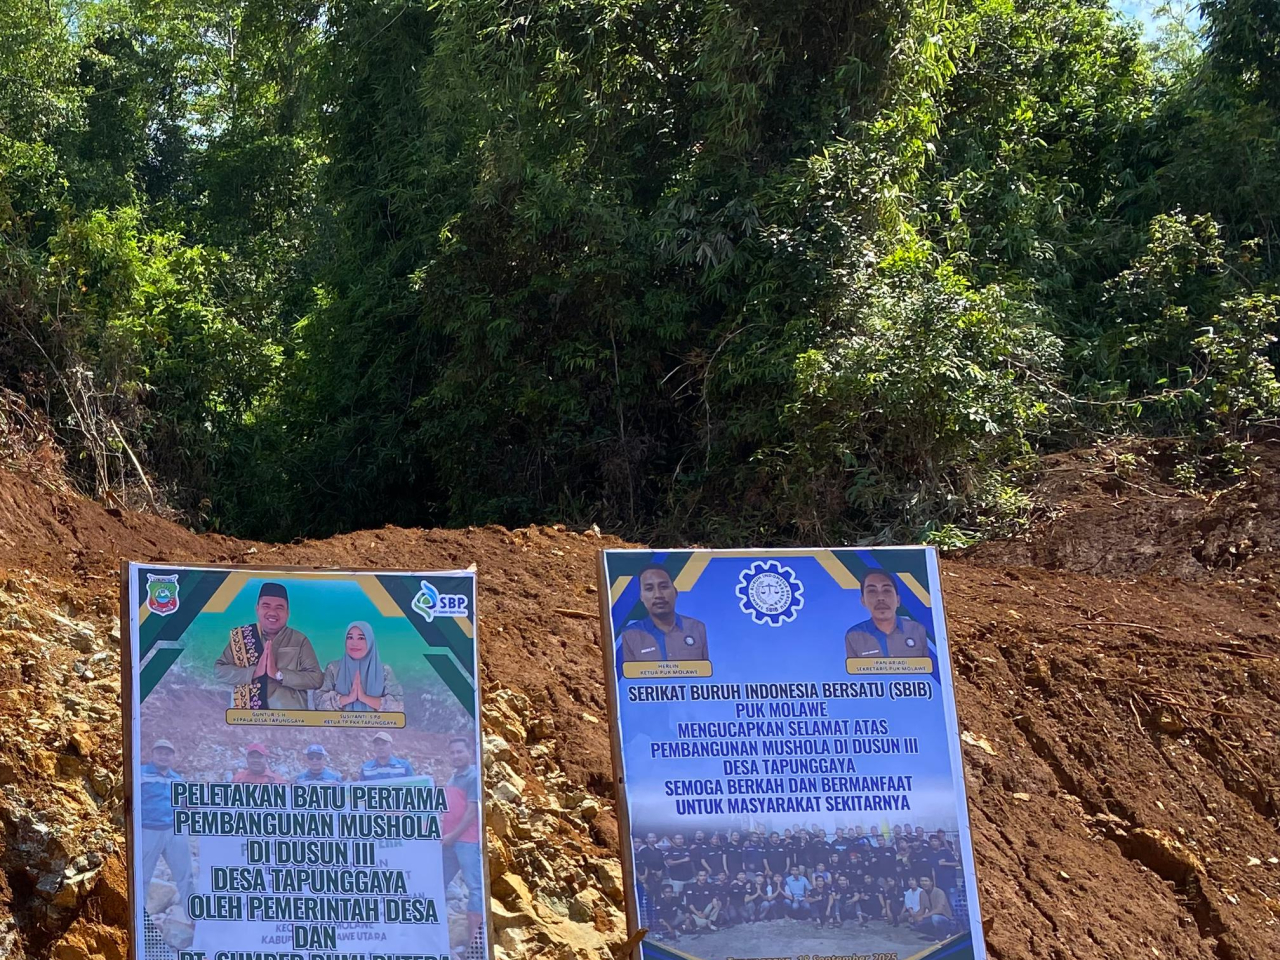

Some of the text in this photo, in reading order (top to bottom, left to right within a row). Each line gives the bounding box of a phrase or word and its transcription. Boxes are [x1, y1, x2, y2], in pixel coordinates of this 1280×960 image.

[440, 597, 465, 609] SBP
[628, 682, 933, 702] SERIKAT BURUH INDONESIA BERSATU (SBIB)
[736, 702, 828, 718] PUK MOLAWE
[678, 719, 888, 738] MENGUCAPKAN SELAMAT ATAS
[651, 738, 919, 758] PEMBANGUNAN MUSHOLA DI DUSUN III
[723, 758, 856, 776] DESA TAPUNGGAYA
[665, 776, 912, 796] SEMOGA BERKAH DAN BERMANFAAT
[171, 781, 449, 812] PELETAKAN BATU PERTAMA
[676, 795, 910, 815] UNTUK MASYARAKAT SEKITARNYA
[174, 809, 442, 840] PEMBANGUNAN MUSHOLA
[247, 839, 270, 865] DI
[275, 840, 348, 867] DUSUN
[353, 841, 375, 867] III
[211, 866, 267, 892] DESA
[270, 867, 408, 895] TAPUNGGAYA
[188, 893, 439, 924] OLEH PEMERINTAH DESA
[292, 924, 337, 951] DAN
